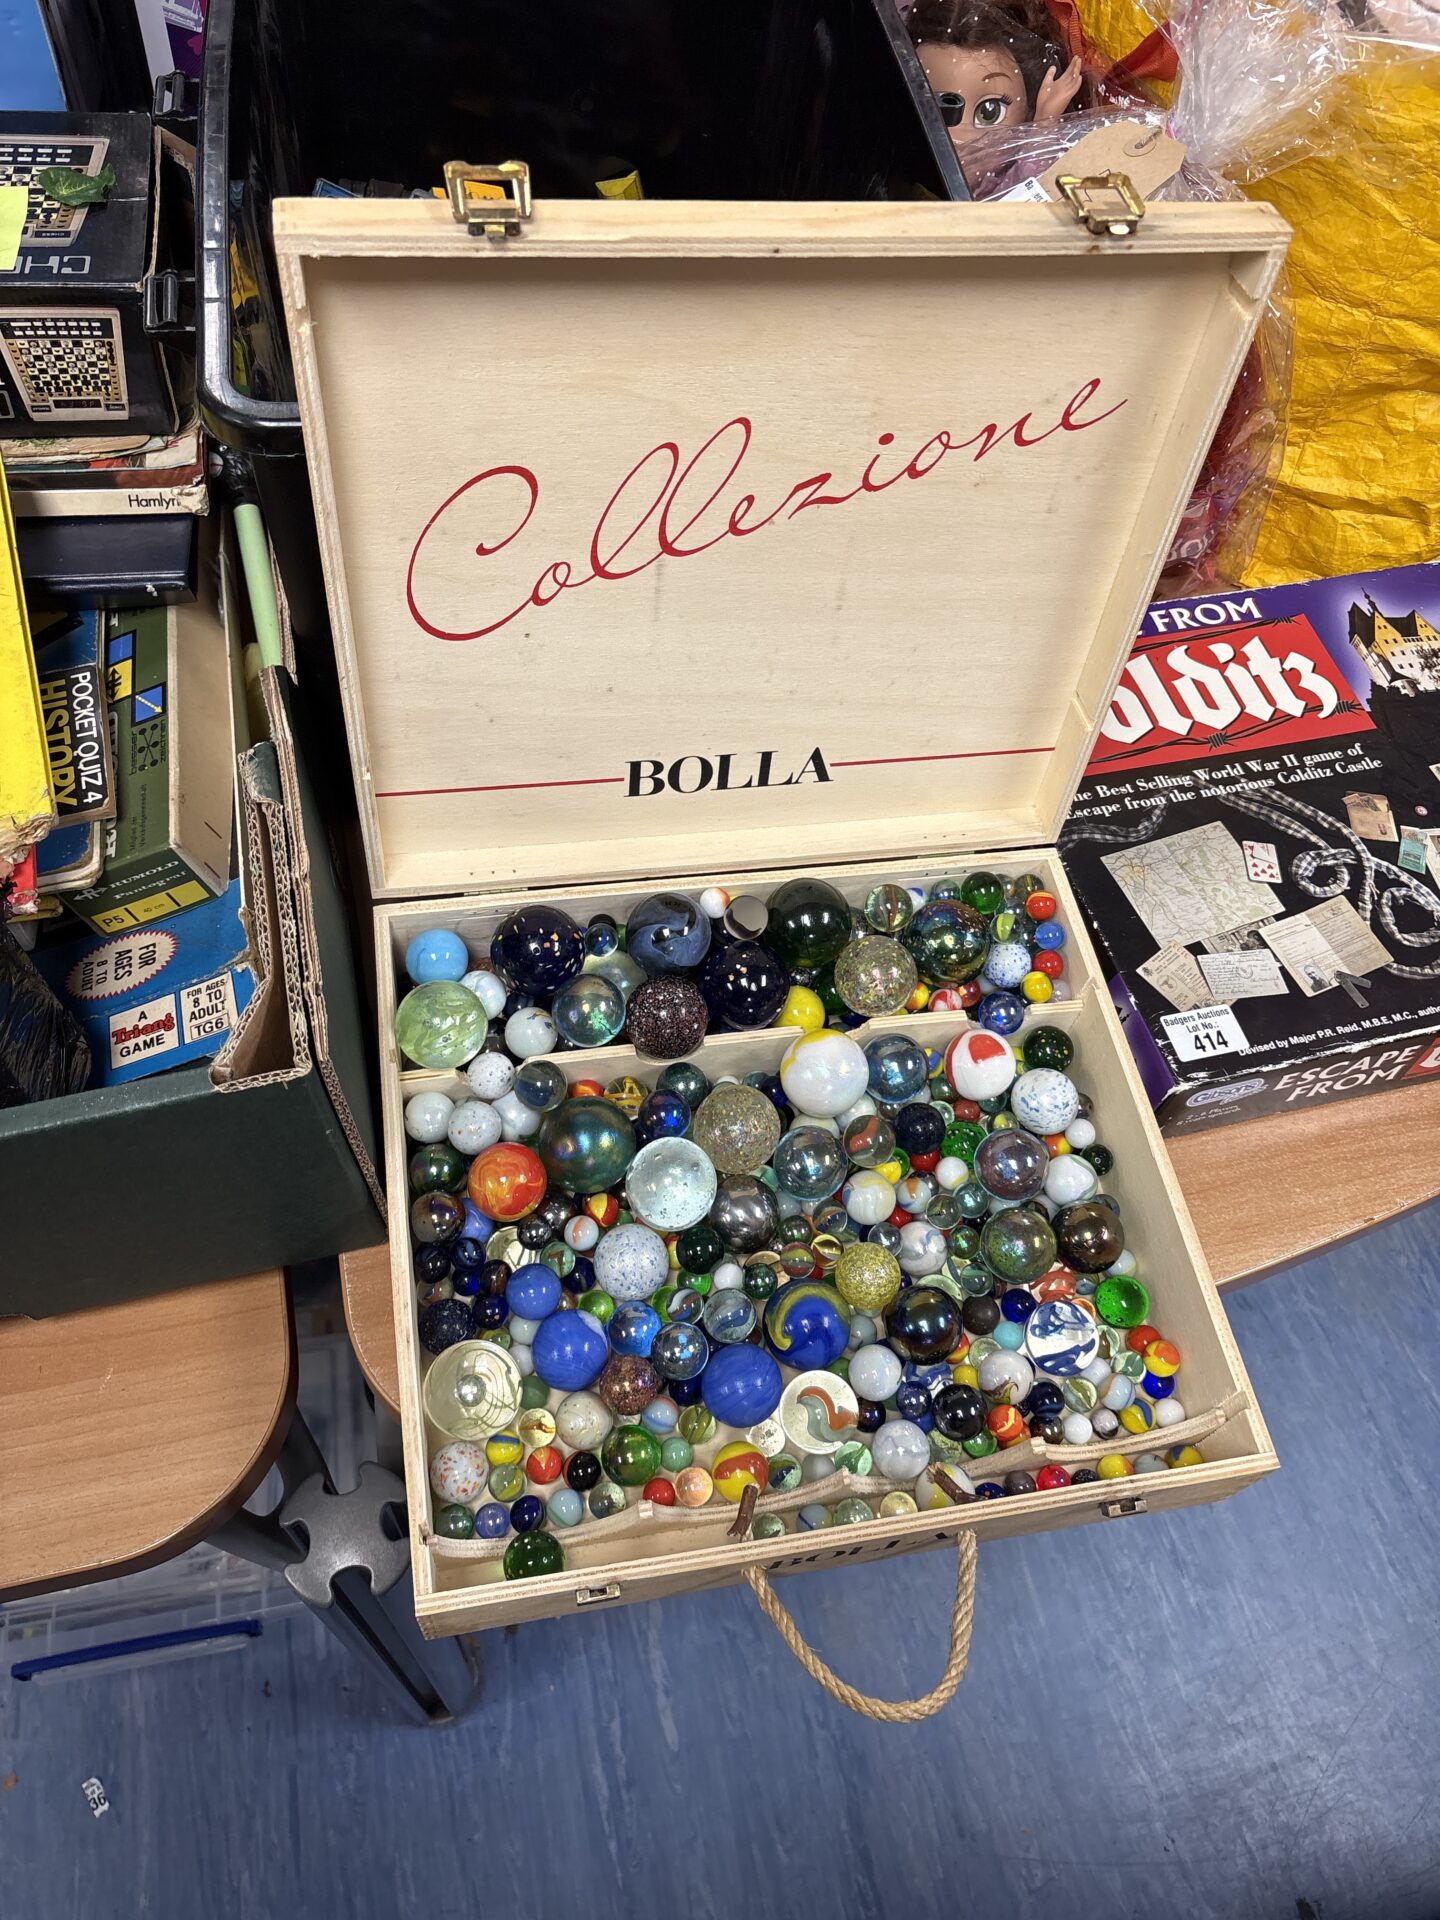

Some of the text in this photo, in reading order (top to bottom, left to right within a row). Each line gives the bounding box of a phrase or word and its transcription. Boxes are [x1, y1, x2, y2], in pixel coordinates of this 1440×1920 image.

[406, 377, 1128, 641] Collezione
[1148, 597, 1263, 633] FROM
[1101, 635, 1339, 745] olditz
[40, 678, 78, 807] HISTORY
[70, 671, 103, 804] POCKET QUIZ 4
[624, 747, 833, 798] BOLLA
[1073, 743, 1365, 802] he Best Selling World War II game of
[1124, 796, 1167, 811] from
[1169, 788, 1197, 803] the
[1199, 776, 1276, 798] notorious
[1277, 767, 1334, 785] Colditz
[1334, 756, 1384, 775] Castle
[109, 860, 179, 889] RUMOLD
[102, 914, 125, 928] P5
[114, 949, 133, 981] AGES
[138, 942, 157, 970] FOR
[82, 961, 95, 992] ADULT
[96, 959, 108, 985] 8 TO
[187, 978, 226, 999] FOR AGES
[193, 989, 223, 1008] 8 TO
[138, 1011, 148, 1023] A
[189, 999, 227, 1023] ADULT
[1163, 1007, 1230, 1027] Badgers Auctions
[193, 1017, 225, 1037] TG6
[1186, 1022, 1201, 1033] Lot
[1193, 1030, 1229, 1052] 414
[1238, 1041, 1277, 1056] Devised
[1276, 1038, 1289, 1050] by
[1288, 1032, 1317, 1046] Major
[1316, 1027, 1336, 1039] P.R.
[1336, 1023, 1363, 1035] Reid,
[119, 1033, 166, 1059] GAME
[1273, 1044, 1423, 1091] ESCAPE
[1285, 1065, 1406, 1102] FROM
